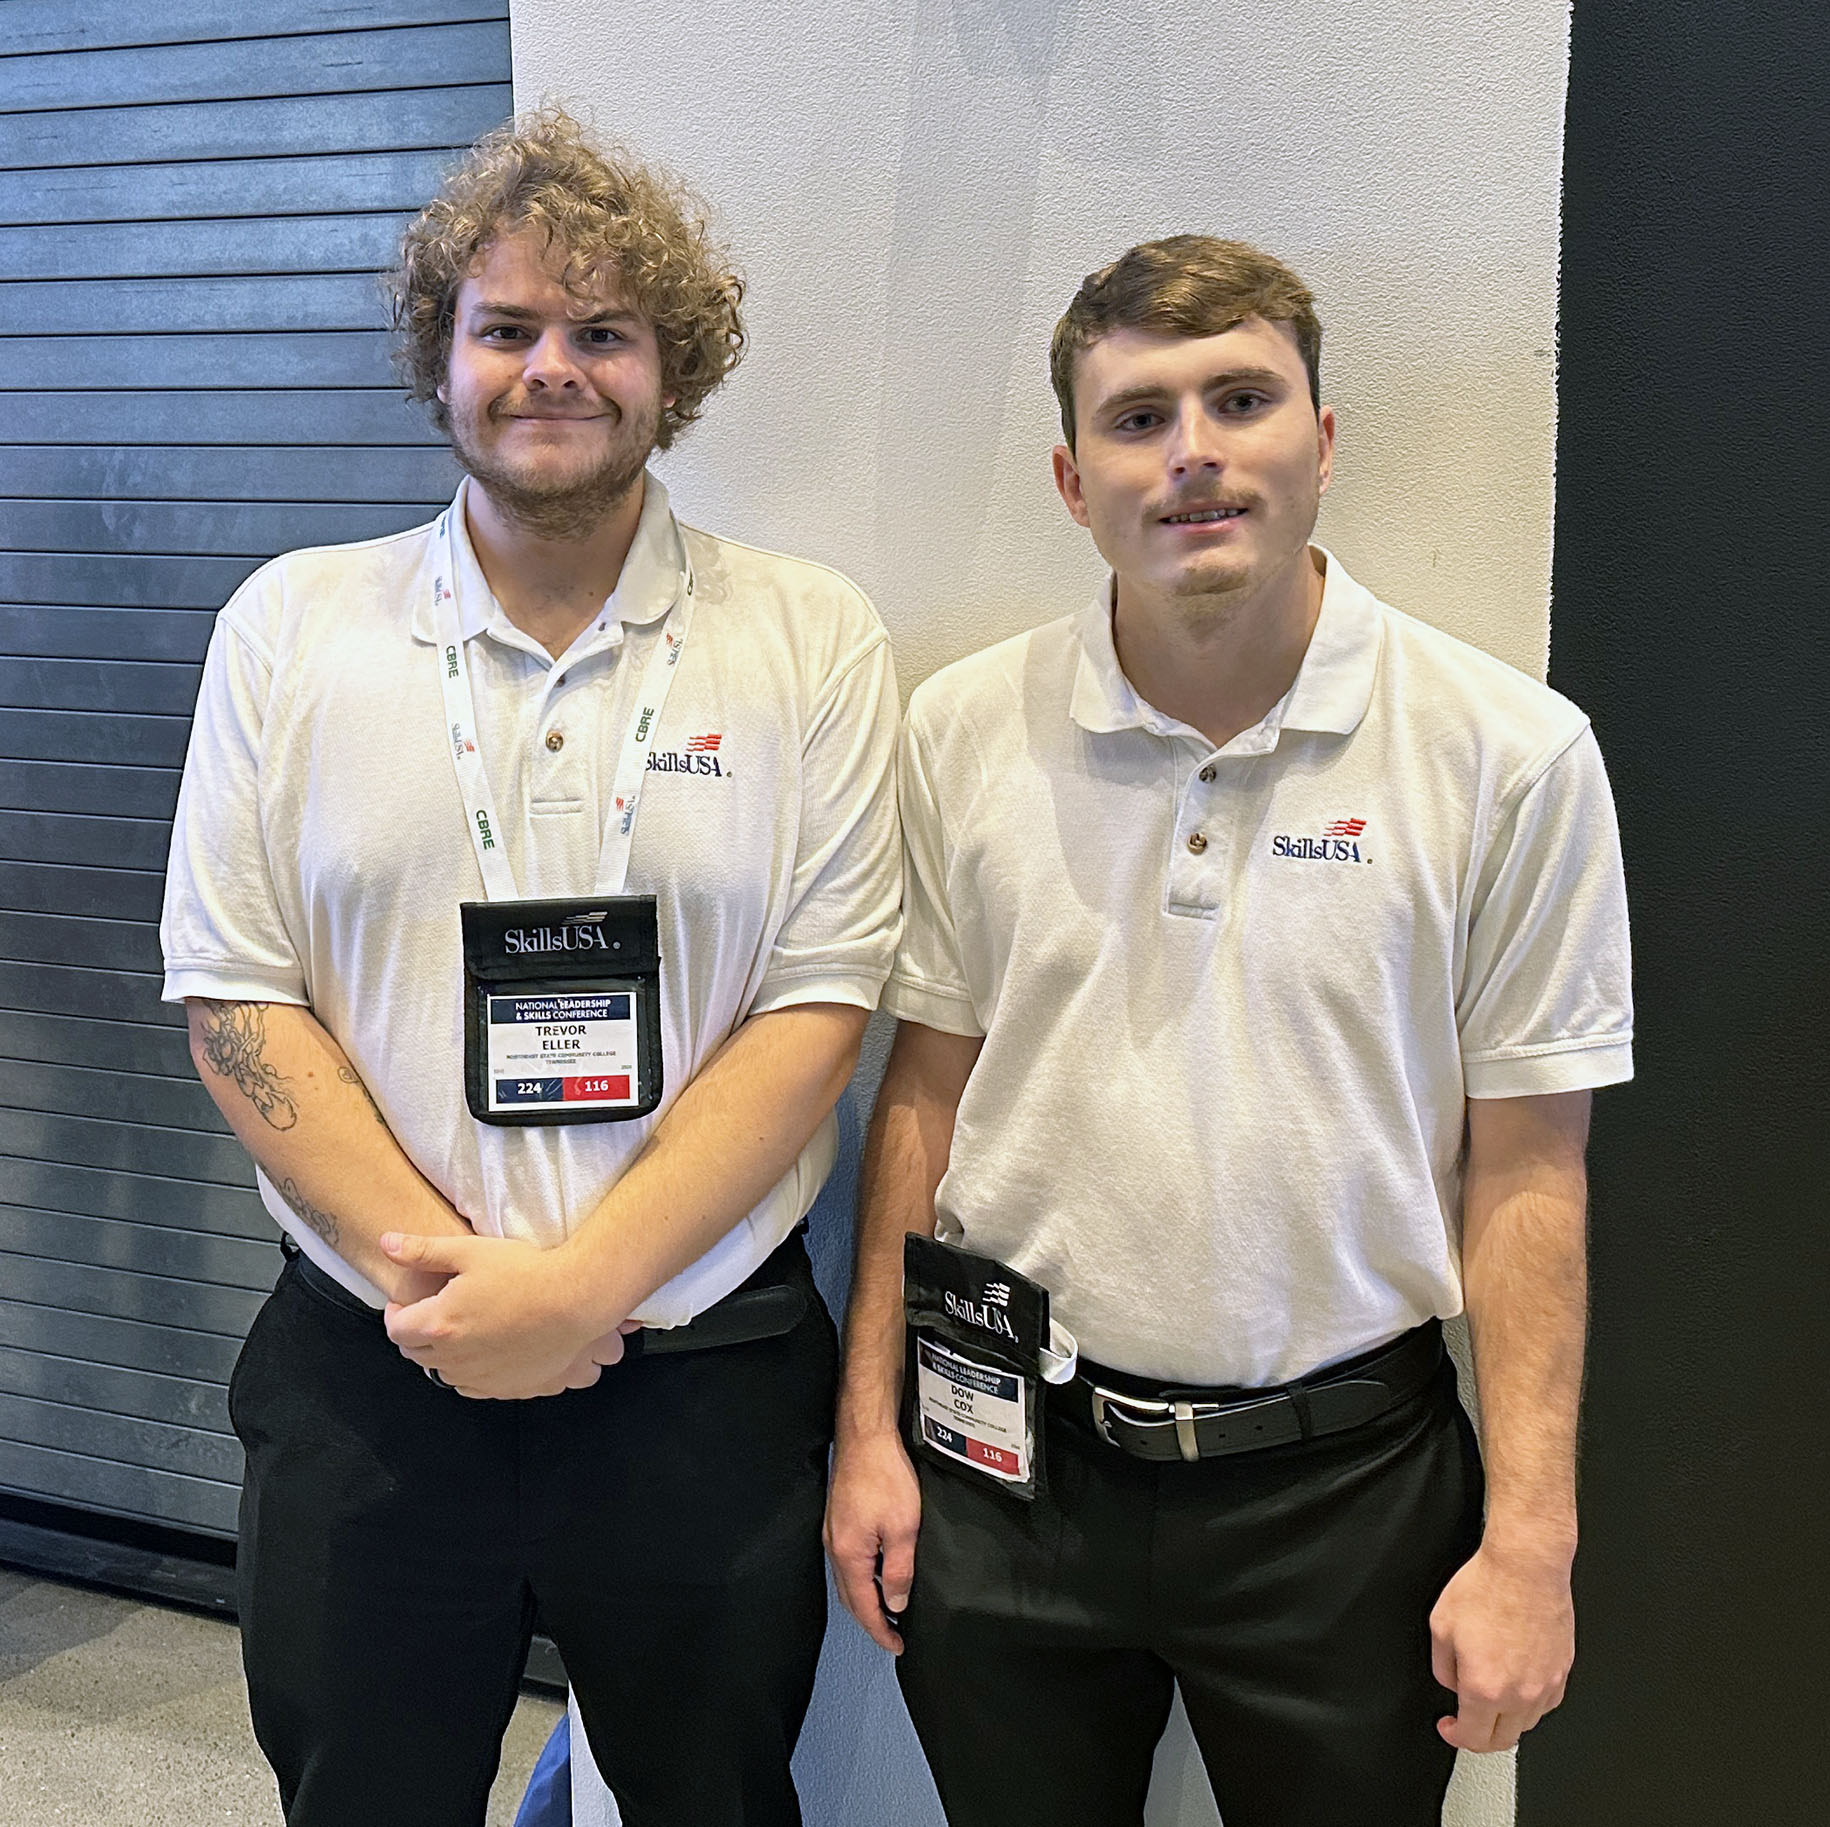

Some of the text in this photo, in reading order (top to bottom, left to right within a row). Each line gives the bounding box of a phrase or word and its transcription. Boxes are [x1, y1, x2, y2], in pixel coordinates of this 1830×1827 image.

[445, 645, 459, 679] CBRE
[635, 706, 655, 743] CBRE
[476, 809, 495, 851] CBRE
[1272, 835, 1362, 863] SkillsUSA
[505, 925, 609, 954] SkillsUSA
[515, 999, 612, 1011] NATIONAL LEADERSHIP
[515, 1009, 608, 1020] & SKILLS CONFERENCE
[535, 1025, 587, 1036] TREVOR
[542, 1040, 581, 1050] ELLER
[517, 1082, 542, 1094] 224
[585, 1080, 609, 1091] 116
[944, 1290, 1017, 1340] SkillsUSA
[955, 1373, 999, 1395] CONFERENCE
[959, 1366, 1001, 1385] LEADERSHIP
[951, 1384, 975, 1402] DOW
[953, 1399, 974, 1415] COX
[936, 1425, 953, 1443] 224
[982, 1447, 1003, 1463] 116
